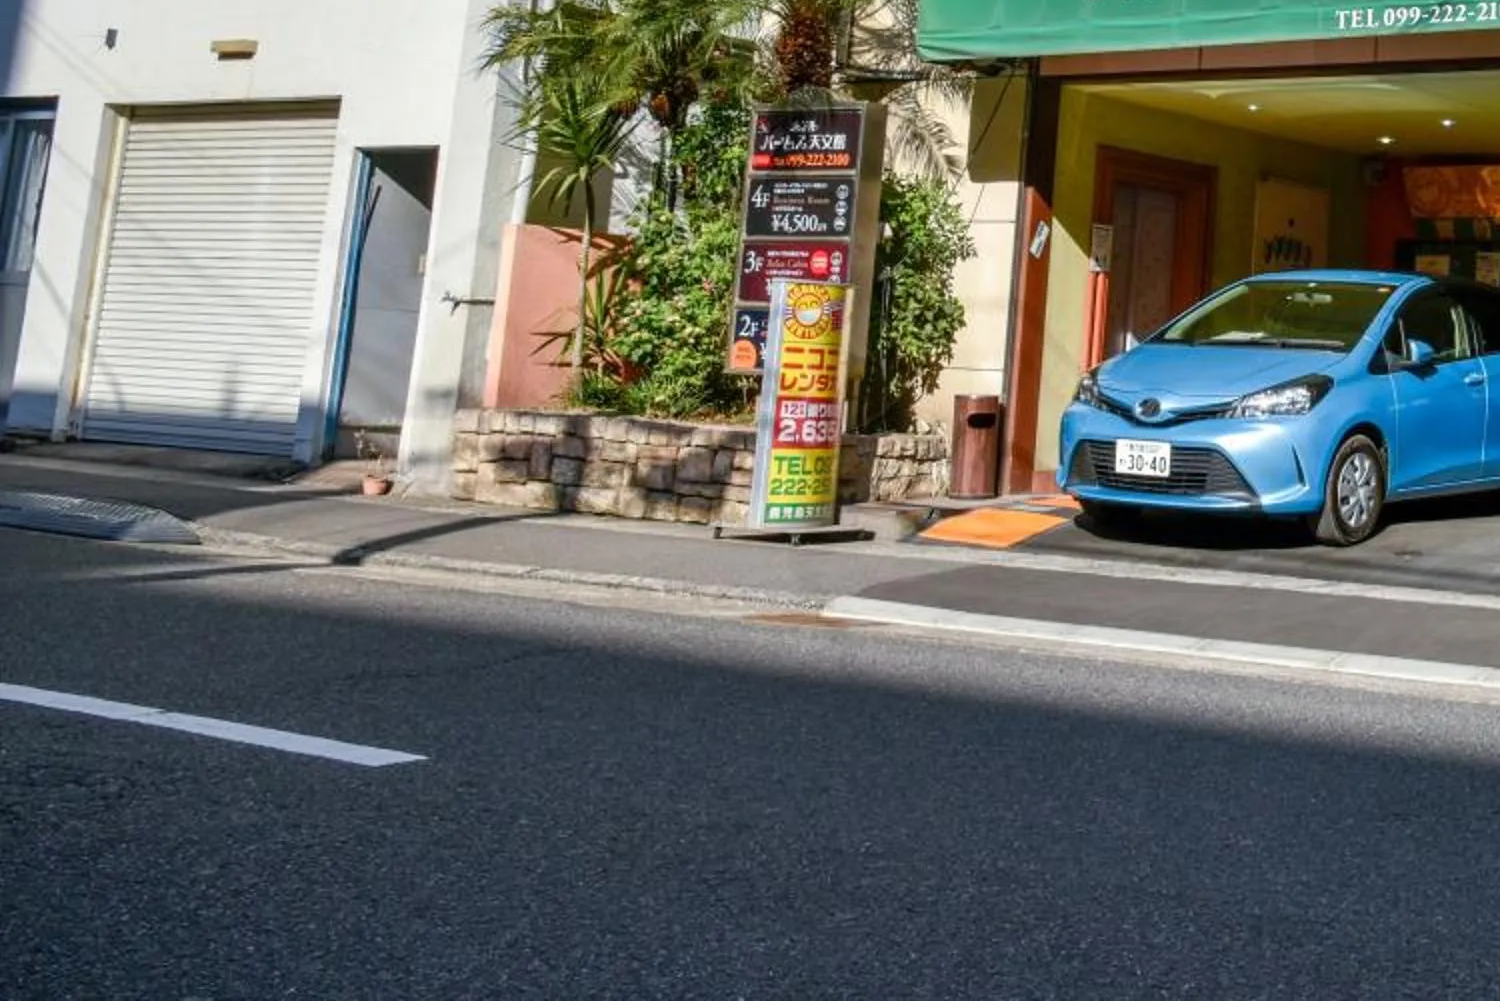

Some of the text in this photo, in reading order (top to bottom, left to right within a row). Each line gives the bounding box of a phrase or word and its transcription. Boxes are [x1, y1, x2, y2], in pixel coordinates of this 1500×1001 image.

[751, 184, 771, 208] 4F
[743, 250, 764, 273] 3F
[739, 315, 759, 337] 2F
